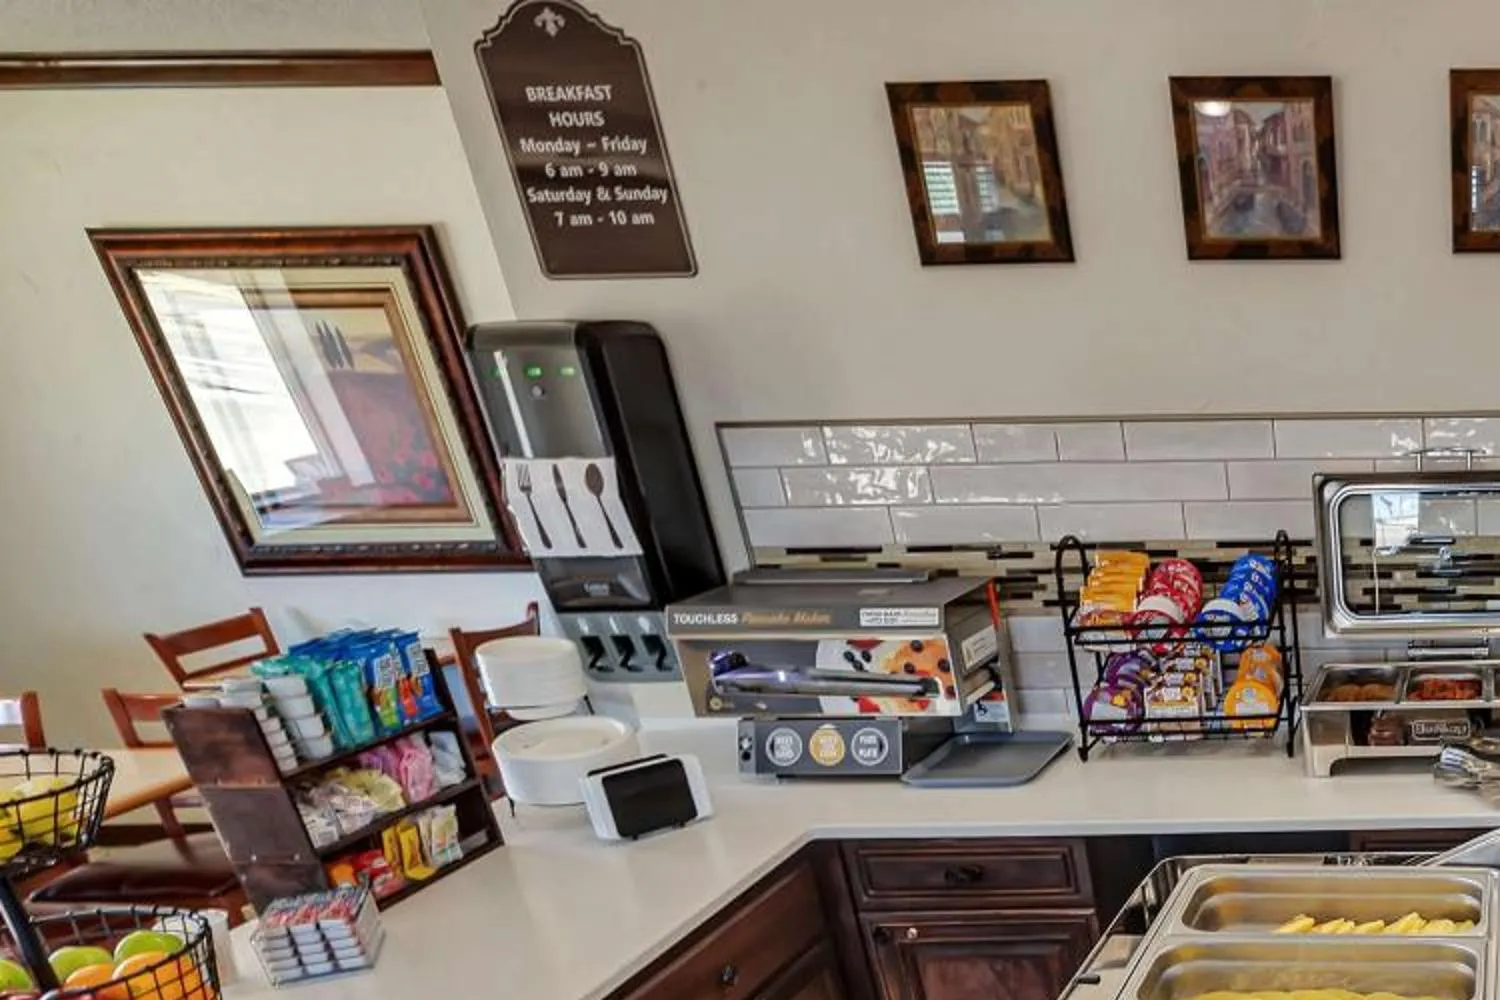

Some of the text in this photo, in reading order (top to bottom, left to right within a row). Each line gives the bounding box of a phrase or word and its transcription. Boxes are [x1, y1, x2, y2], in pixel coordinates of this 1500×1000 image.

[525, 85, 612, 102] BREAKFAST
[549, 111, 605, 128] HOURS
[520, 137, 580, 156] Monday
[601, 135, 647, 155] Friday
[545, 162, 556, 178] 6
[560, 165, 583, 178] am
[598, 161, 609, 177] 9
[614, 164, 637, 177] am
[526, 185, 668, 205] Saturday & Sunday
[554, 211, 564, 227] 7
[570, 214, 593, 226] am
[608, 210, 627, 225] 10
[631, 213, 655, 225] am
[673, 612, 738, 625] TOUCHLESS
